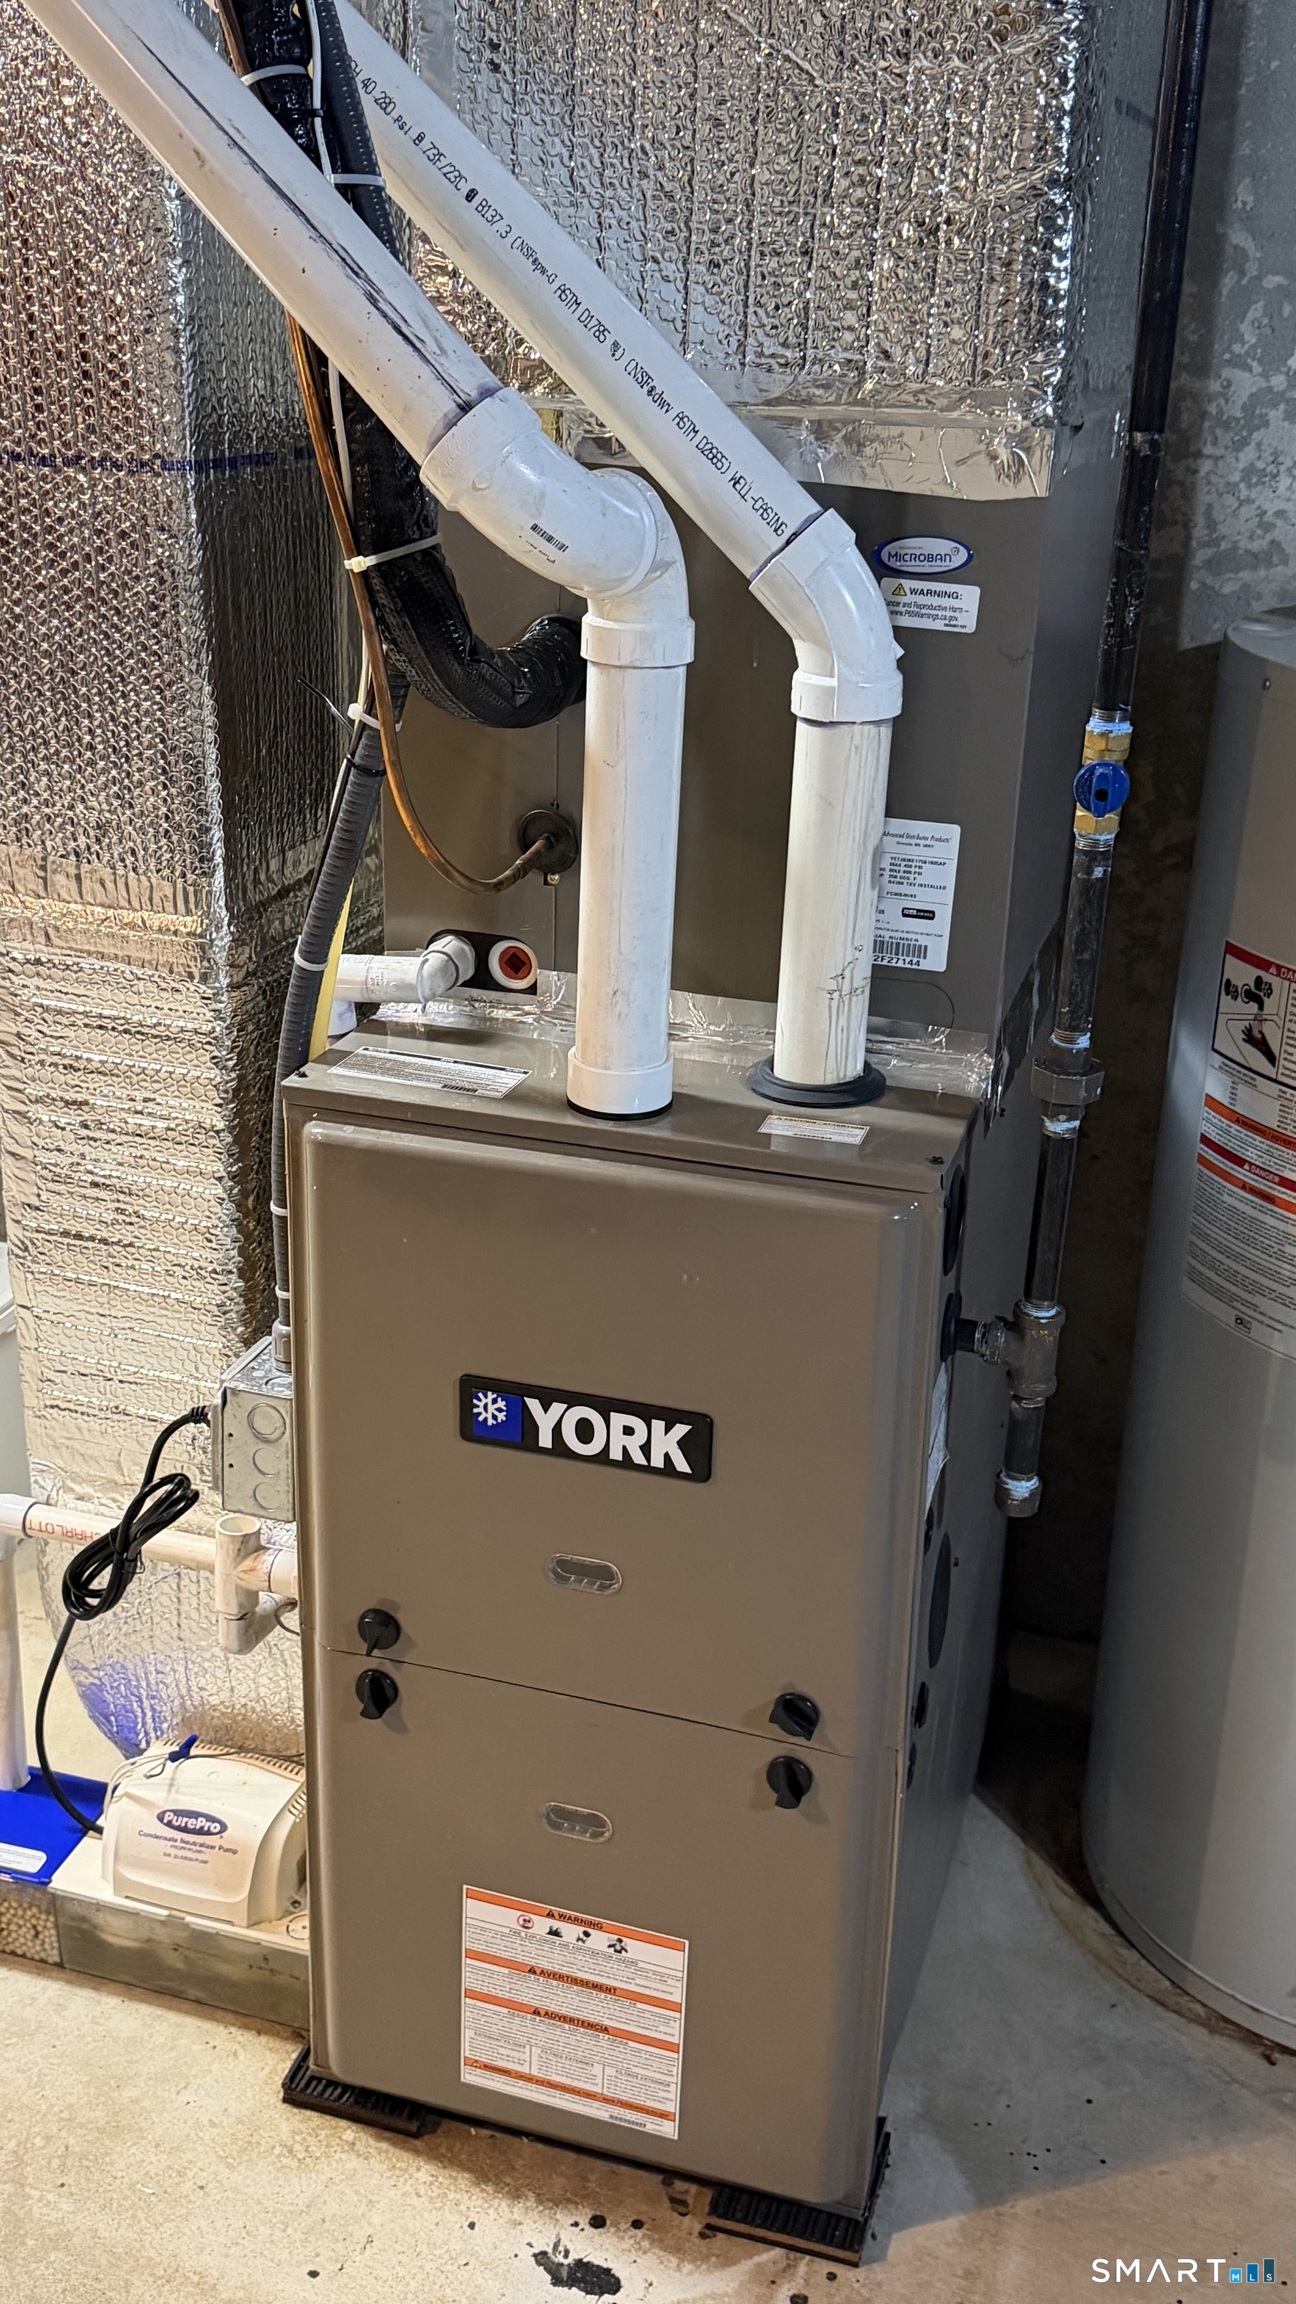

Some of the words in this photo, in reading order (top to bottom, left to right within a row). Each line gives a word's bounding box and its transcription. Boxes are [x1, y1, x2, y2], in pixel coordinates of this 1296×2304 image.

[361, 77, 377, 95] 40
[374, 91, 397, 116] 280
[554, 283, 582, 315] ASTM
[577, 308, 612, 344] D1785
[672, 410, 700, 442] ASTM
[728, 471, 788, 537] WELL-CASING
[909, 586, 963, 600] WARNING:
[913, 602, 948, 612] Reproductive
[524, 1397, 693, 1474] YORK
[163, 1811, 221, 1833] PurePro
[180, 1837, 217, 1851] Neutralizer
[218, 1844, 239, 1855] Pump
[558, 1912, 604, 1930] WARNING
[540, 1969, 618, 1995] AVERTISSEMENT
[544, 2010, 610, 2034] ADVERTENCIA
